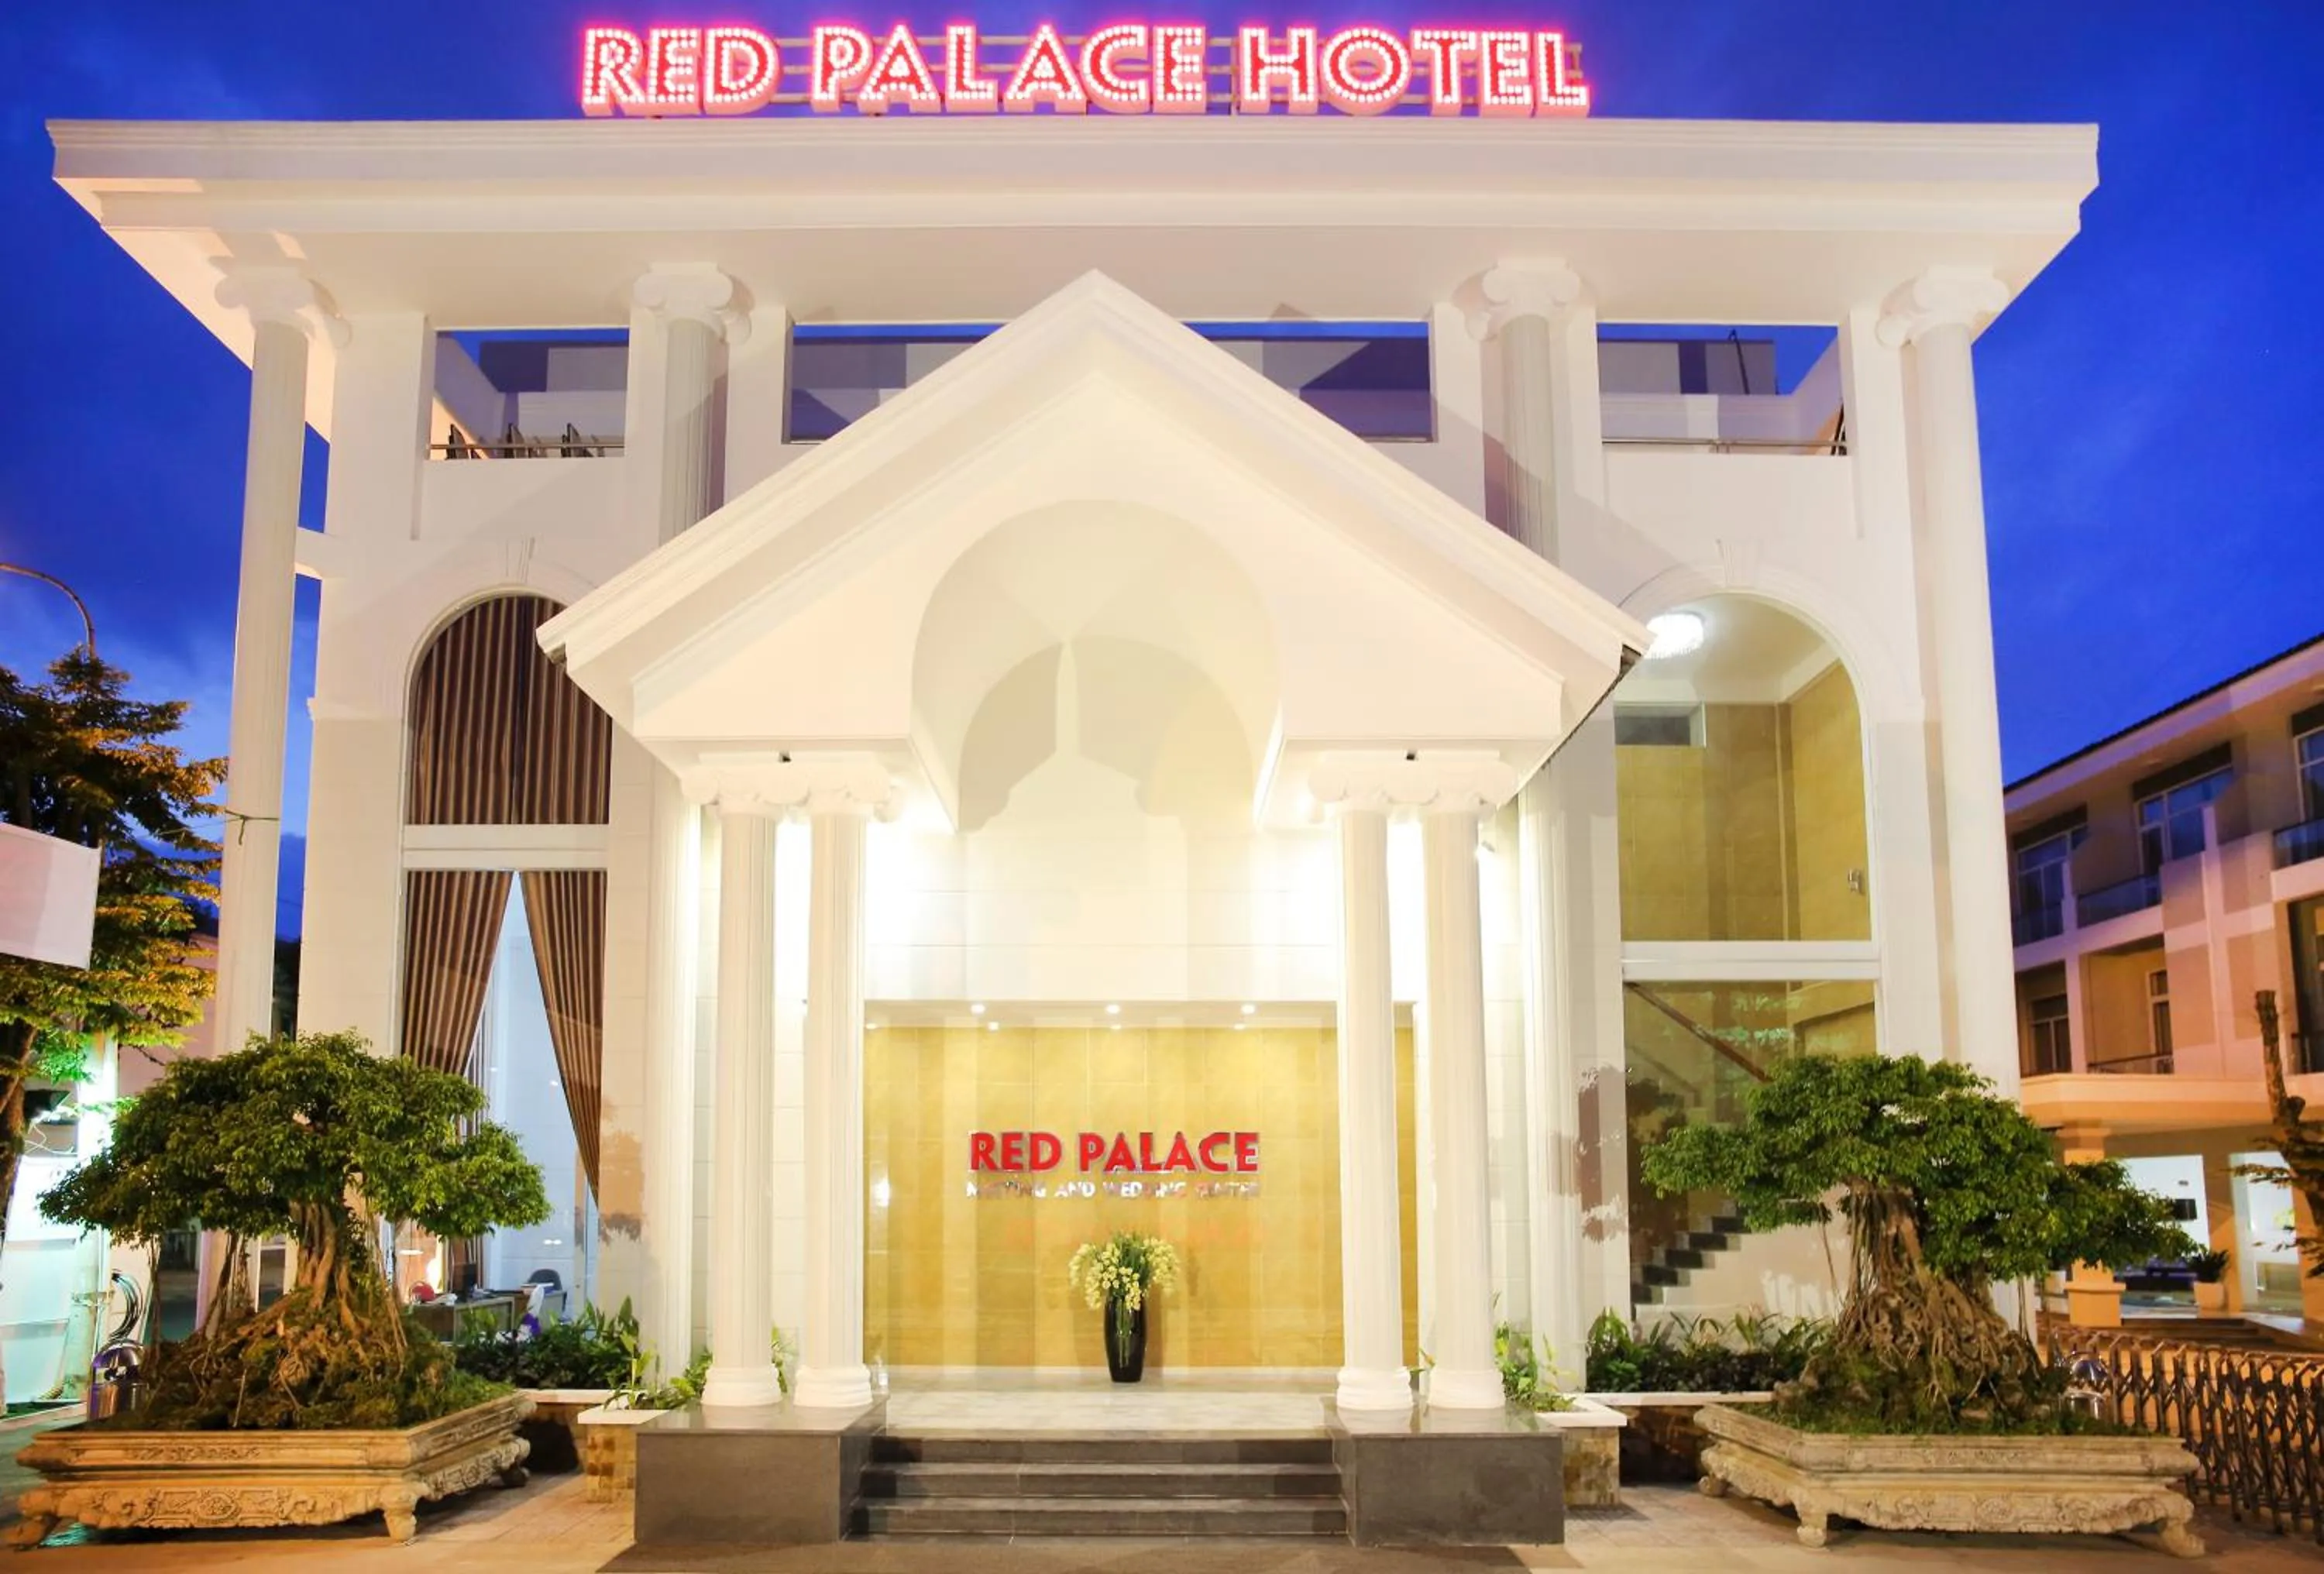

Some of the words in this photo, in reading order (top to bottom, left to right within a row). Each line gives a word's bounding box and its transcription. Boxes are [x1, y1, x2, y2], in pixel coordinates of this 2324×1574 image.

[582, 26, 781, 115] RED
[811, 23, 1206, 114] PALACE
[1239, 26, 1590, 117] HOTEL
[970, 1131, 1063, 1172] RED
[1078, 1131, 1260, 1173] PALACE
